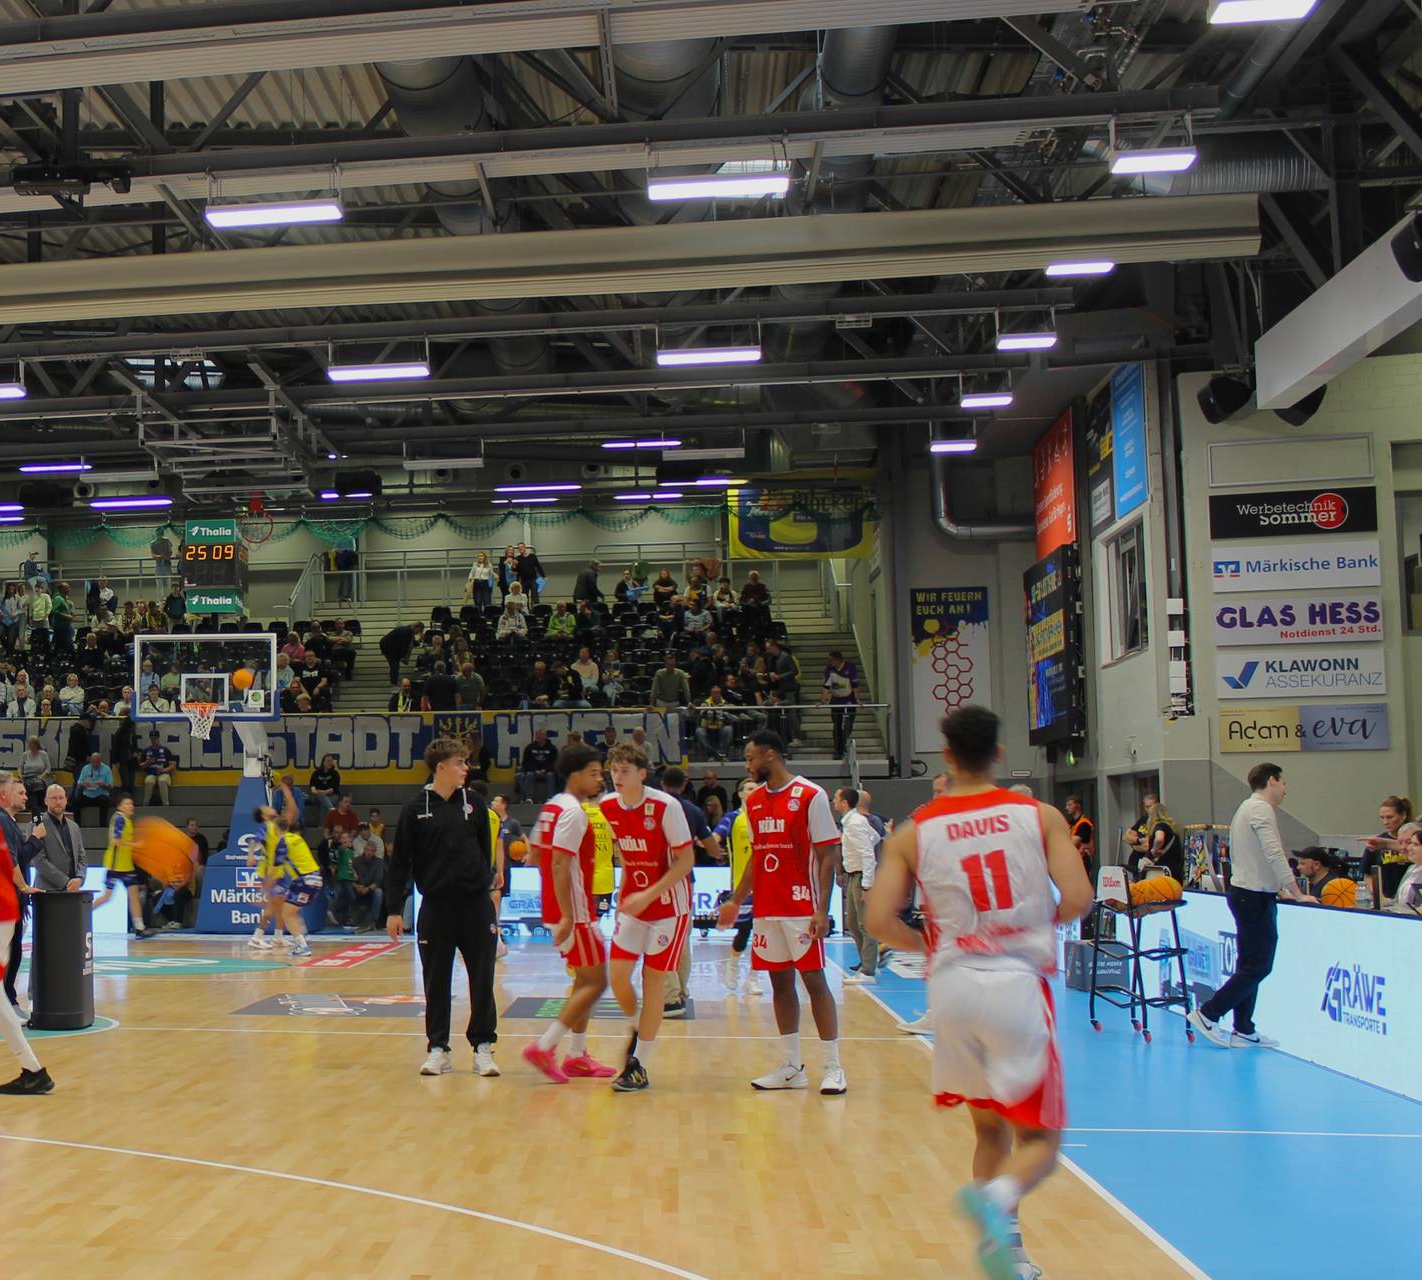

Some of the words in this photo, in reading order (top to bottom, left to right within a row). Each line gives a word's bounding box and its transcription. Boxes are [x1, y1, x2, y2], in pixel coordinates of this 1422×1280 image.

[1236, 499, 1336, 516] Werbetechnik
[1260, 511, 1337, 526] Sommer
[200, 527, 232, 536] Thalia
[1246, 558, 1330, 573] Märkische
[1337, 554, 1378, 569] Bank
[200, 596, 232, 605] Thalia
[916, 592, 937, 602] WIR
[941, 591, 982, 602] FEUERN
[916, 604, 944, 615] EUCH
[1216, 604, 1296, 628] GLAS
[1308, 601, 1380, 625] HESS
[1280, 628, 1336, 639] Notdienst
[1340, 626, 1354, 635] 24
[1359, 625, 1381, 634] Std.
[1265, 657, 1359, 673] KLAWONN
[1265, 671, 1384, 688] ASSEKURANZ
[1229, 720, 1289, 740] Adam
[1294, 724, 1307, 738] &
[1313, 716, 1376, 740] eva
[758, 817, 785, 834] KÖLN
[946, 814, 1010, 842] DAVIS
[960, 850, 1014, 912] 11
[1102, 876, 1121, 888] Wilson
[211, 888, 268, 903] Märkis
[792, 885, 810, 901] 34
[1321, 961, 1386, 1023] GRÄWE
[1342, 1011, 1380, 1034] TRANSPORTE
